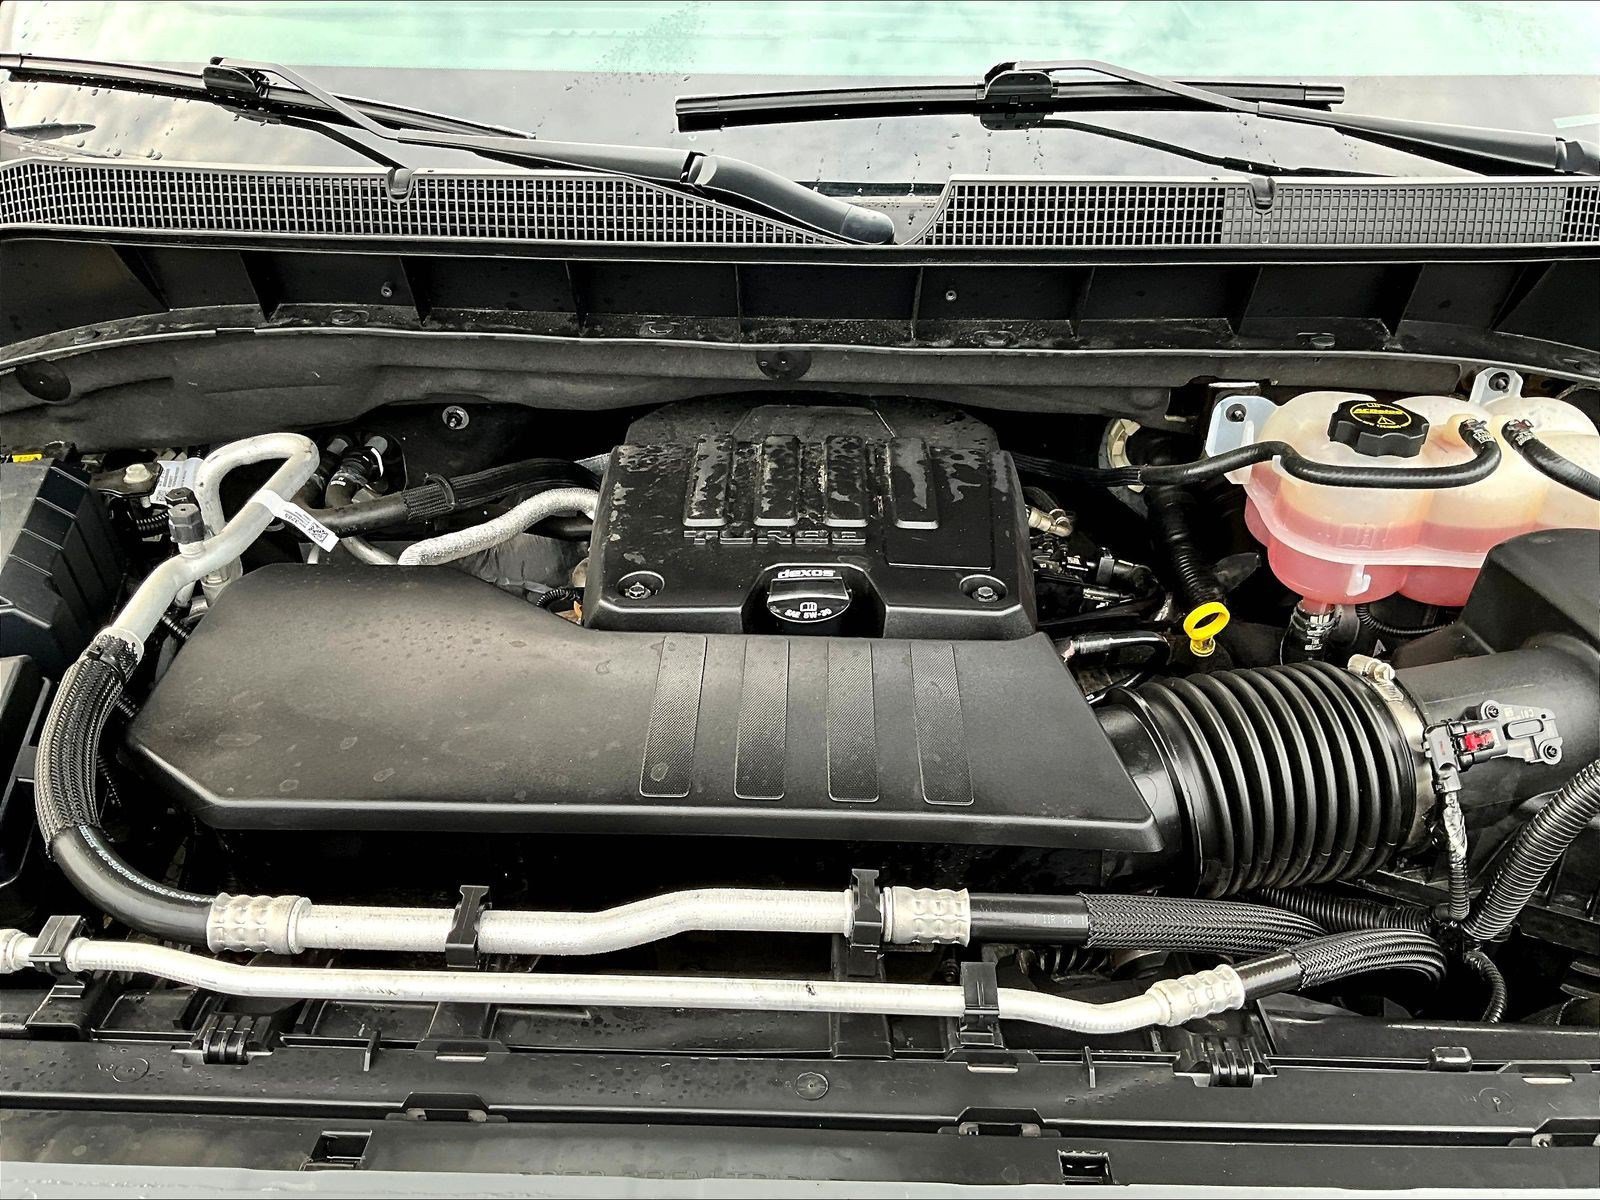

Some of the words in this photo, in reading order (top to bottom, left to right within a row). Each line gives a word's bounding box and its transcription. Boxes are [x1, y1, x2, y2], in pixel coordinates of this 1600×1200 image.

[777, 569, 835, 579] dexos
[109, 861, 143, 884] SUCTION
[142, 882, 167, 894] HOSE
